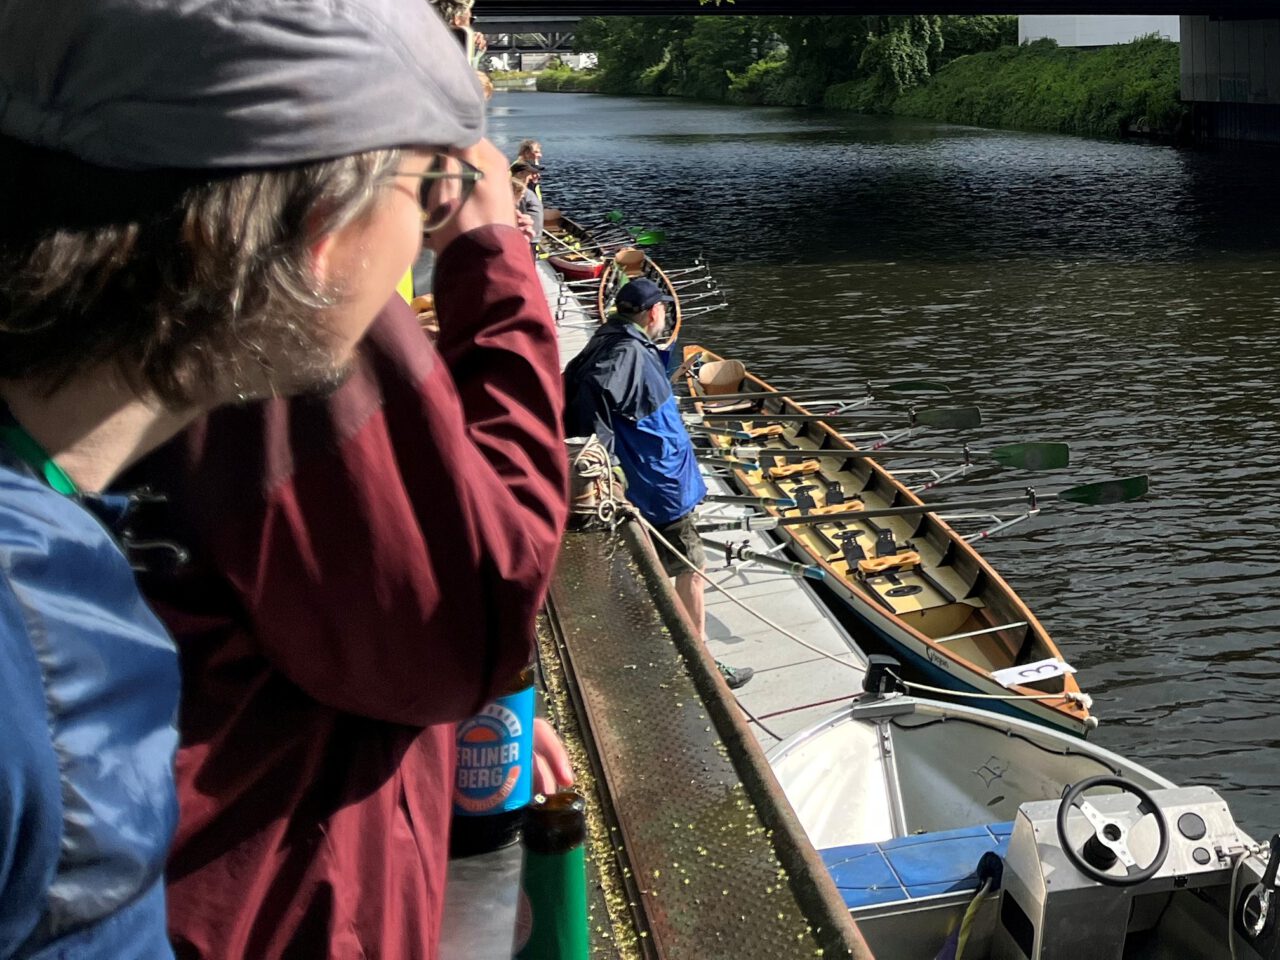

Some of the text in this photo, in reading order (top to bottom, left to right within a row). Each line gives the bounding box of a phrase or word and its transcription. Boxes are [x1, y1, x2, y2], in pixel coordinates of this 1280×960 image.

[1018, 664, 1058, 678] 3
[457, 742, 520, 768] ERLINER
[458, 768, 503, 789] BERG
